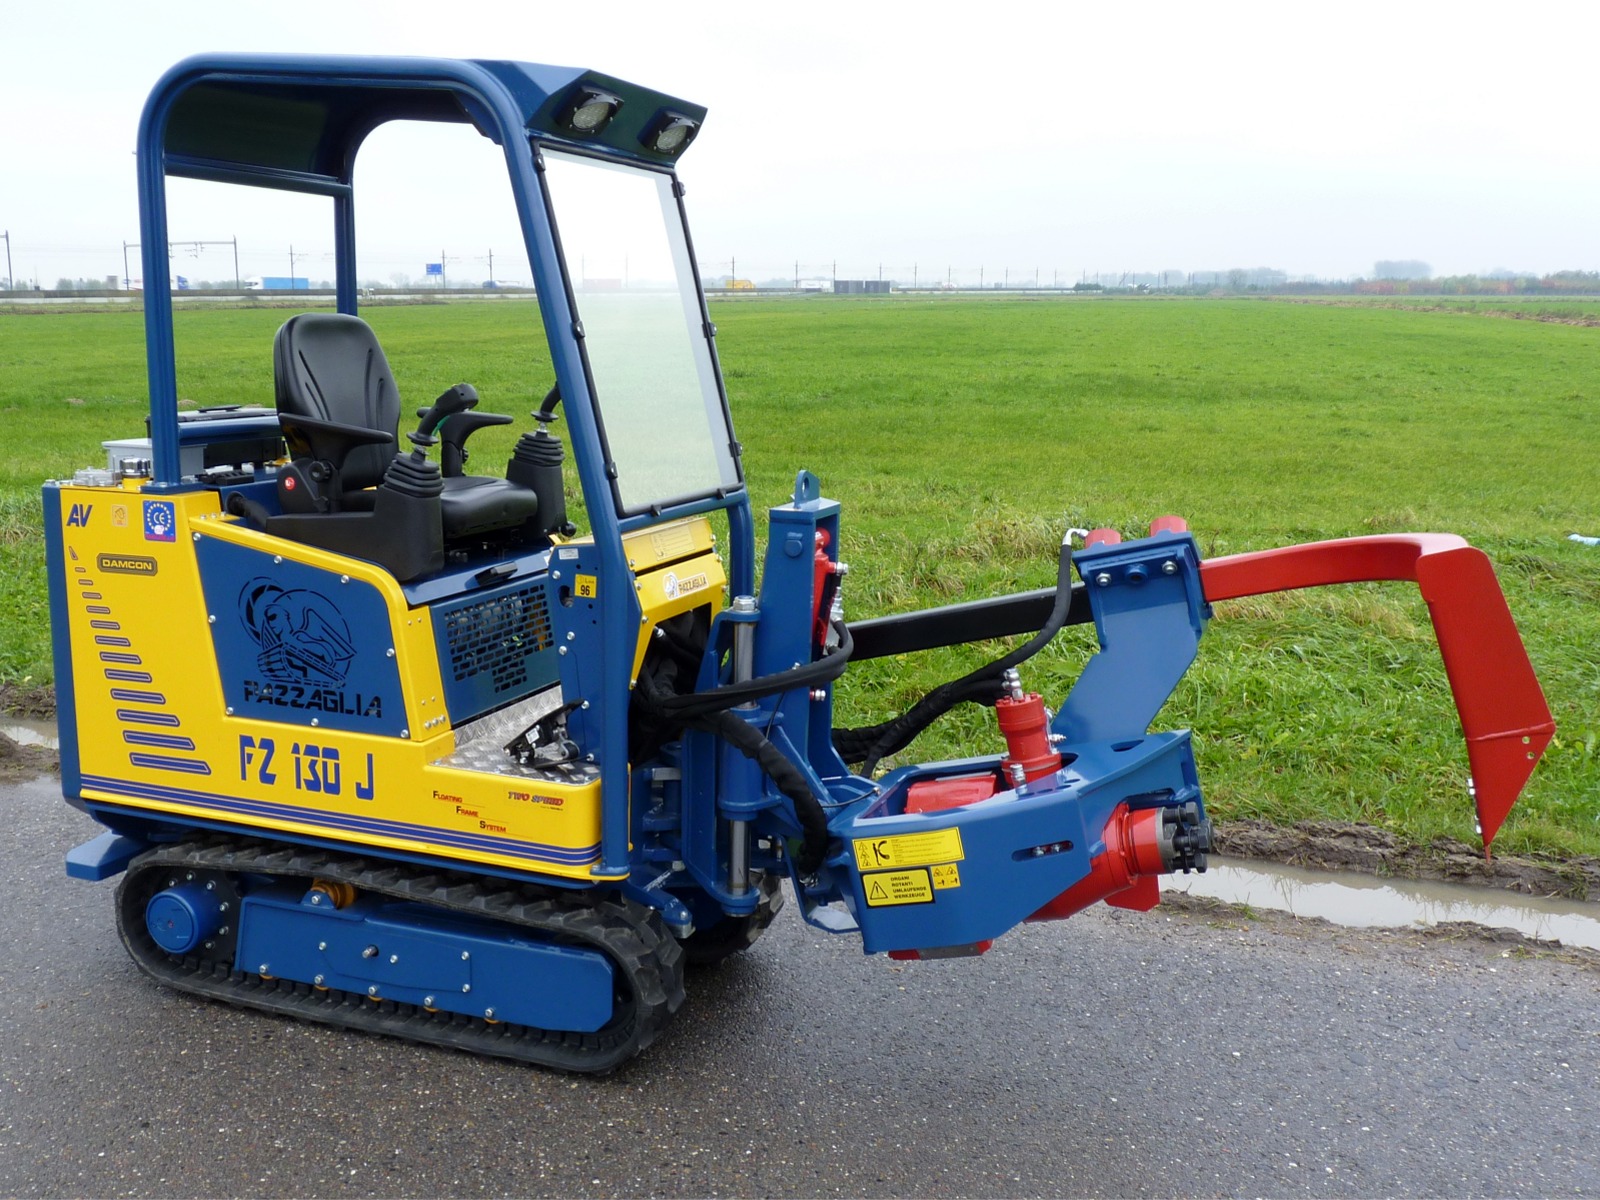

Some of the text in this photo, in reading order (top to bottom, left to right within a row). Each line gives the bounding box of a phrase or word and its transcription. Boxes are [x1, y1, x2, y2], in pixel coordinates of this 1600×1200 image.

[66, 503, 93, 528] AV
[102, 558, 153, 571] DAMCON
[580, 584, 591, 596] 96
[677, 575, 708, 595] PAZZAGLIA
[243, 679, 382, 719] PAZZAGLIA
[239, 734, 375, 801] FZ 130 J
[432, 790, 463, 804] FLOATING
[508, 790, 565, 807] TWO SPEED
[455, 805, 480, 818] FRAME
[479, 820, 507, 833] SYSTEM
[892, 886, 928, 894] UMLAUFENDE
[893, 892, 926, 900] WERKZEUGE
